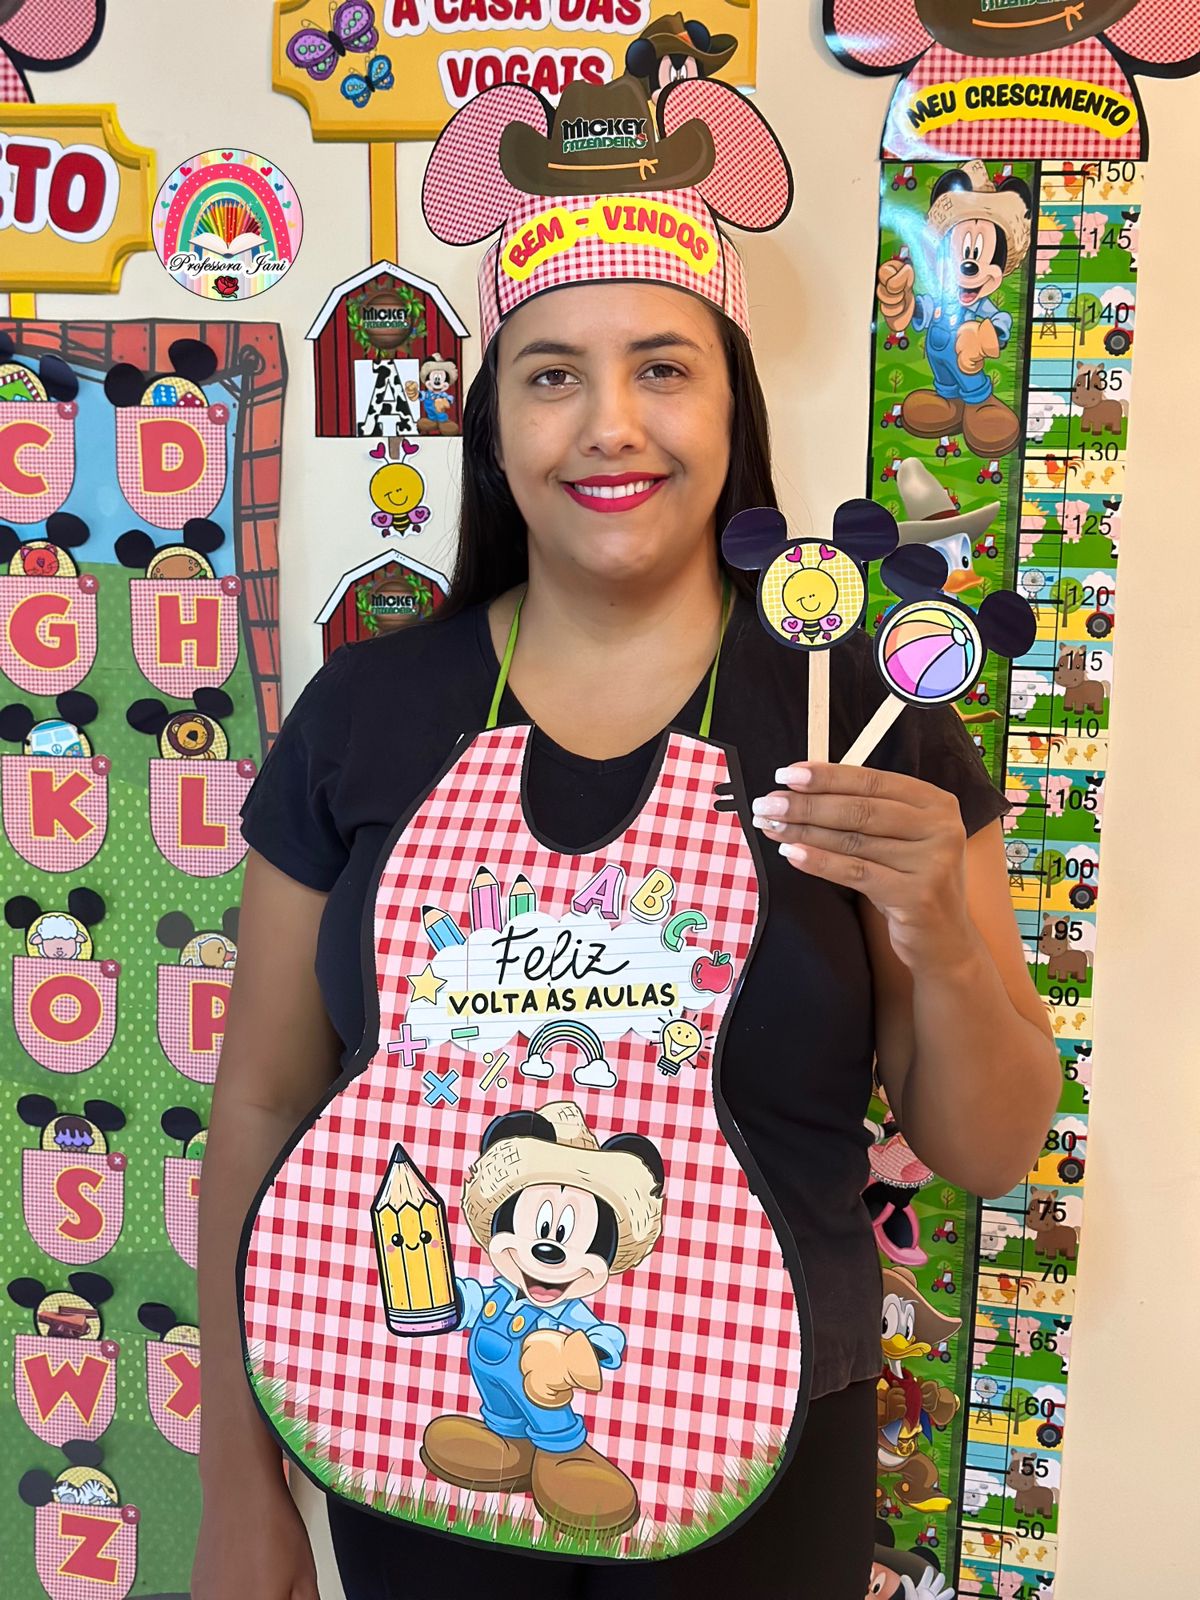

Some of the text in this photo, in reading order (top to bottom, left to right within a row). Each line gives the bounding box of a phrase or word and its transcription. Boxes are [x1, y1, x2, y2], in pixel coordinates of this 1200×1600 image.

[392, 0, 642, 27] A CASA DAS
[447, 55, 605, 98] VOGAIS
[907, 83, 1131, 129] MEU CRESCIMENTO
[562, 117, 646, 140] MICKEY
[1096, 160, 1136, 183] 150
[0, 142, 107, 234] TO
[508, 216, 565, 268] BEM
[602, 205, 709, 261] VINDOS
[1090, 228, 1132, 250] 145
[362, 307, 411, 321] MICKEY
[1087, 302, 1130, 324] 140
[1083, 370, 1123, 391] 135
[137, 417, 208, 497] D
[1077, 442, 1119, 462] 130
[1072, 515, 1112, 536] 125
[371, 594, 418, 607] MICKEY
[1068, 586, 1110, 607] 120
[6, 591, 80, 671] G
[155, 592, 220, 671] H
[1066, 650, 1103, 671] 115
[1060, 717, 1099, 739] 110
[29, 767, 97, 843] K
[178, 774, 228, 848] L
[1055, 789, 1098, 811] 105
[1052, 857, 1095, 879] 100
[1054, 920, 1083, 942] 95
[491, 925, 630, 985] Feliz
[448, 988, 539, 1015] VOLTA
[585, 982, 676, 1010] AULAS
[1048, 986, 1080, 1007] 90
[27, 973, 104, 1044] O
[1045, 1129, 1077, 1152] 80
[55, 1165, 105, 1242] S
[1038, 1200, 1067, 1223] 75
[1038, 1262, 1068, 1285] 70
[1030, 1331, 1058, 1353] 65
[22, 1353, 111, 1426] W
[1024, 1396, 1056, 1419] 60
[1021, 1457, 1049, 1478] 55
[1015, 1520, 1045, 1540] 50
[57, 1511, 123, 1585] Z
